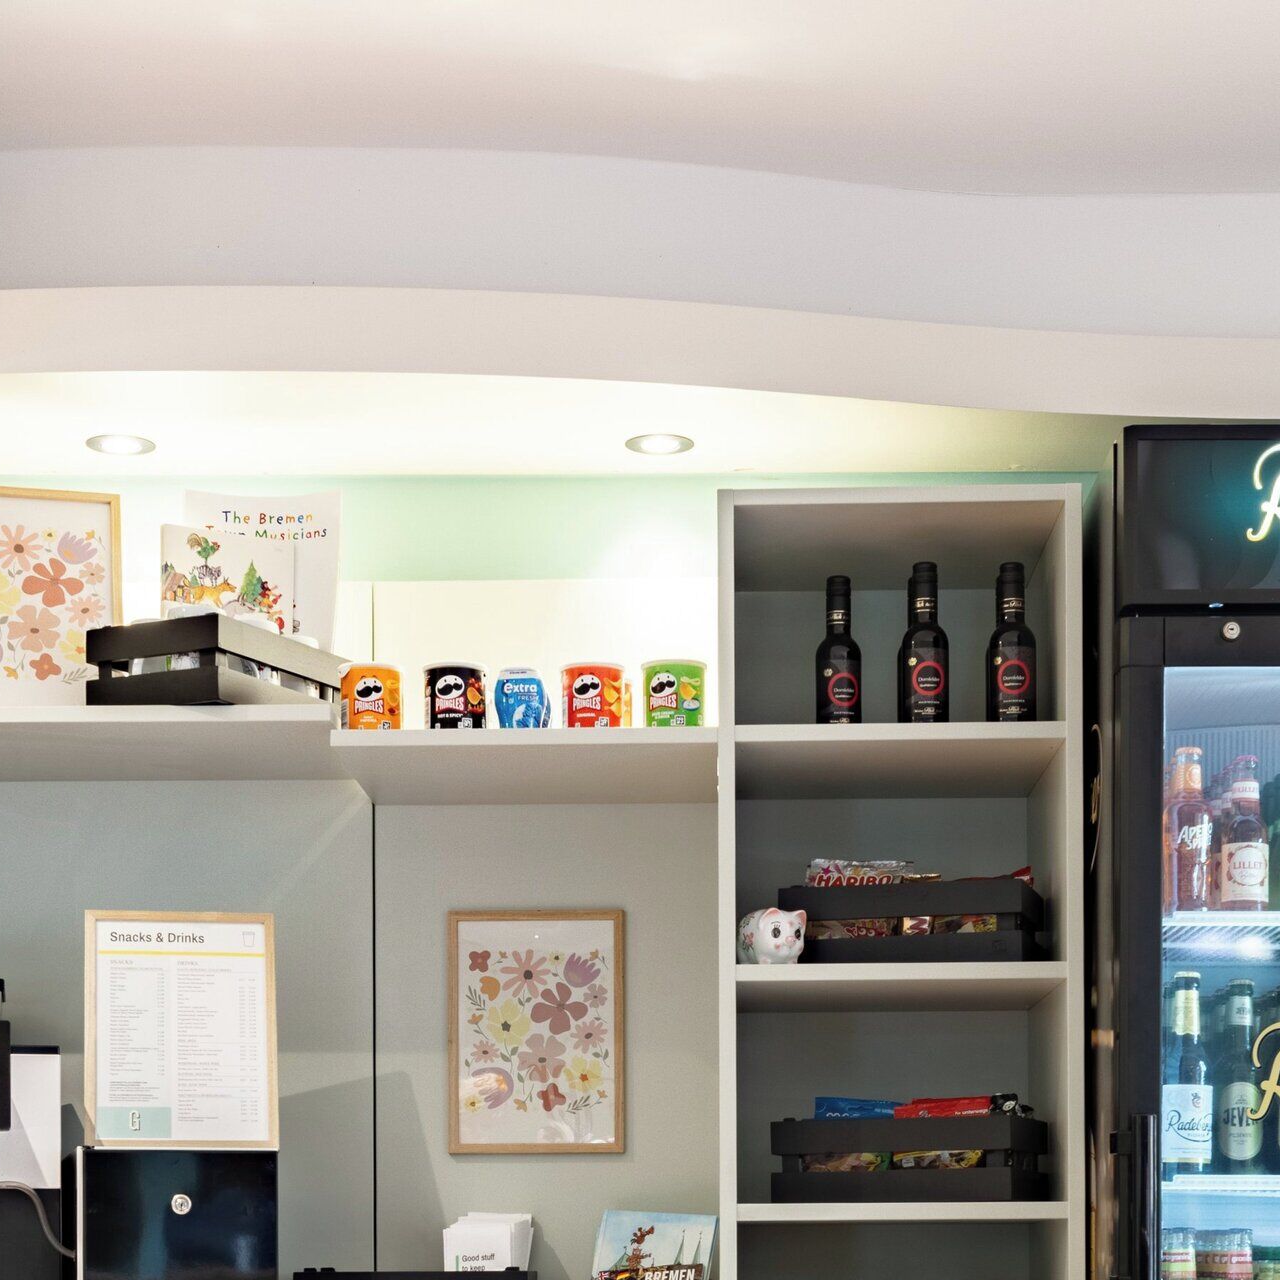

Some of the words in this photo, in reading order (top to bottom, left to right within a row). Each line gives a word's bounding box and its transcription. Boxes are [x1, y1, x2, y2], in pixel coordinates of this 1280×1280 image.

[222, 510, 250, 524] The
[259, 512, 313, 525] Bremen
[255, 528, 327, 541] Musicians
[504, 682, 538, 694] extra
[354, 699, 384, 714] PRINGLES
[435, 697, 464, 712] PRINGLES
[573, 696, 601, 712] PRINGLES
[649, 695, 677, 711] PRINGLES
[110, 931, 152, 943] Snacks
[156, 933, 164, 943] &
[168, 932, 205, 944] Drinks
[461, 1254, 479, 1262] Good
[481, 1253, 496, 1261] stuff
